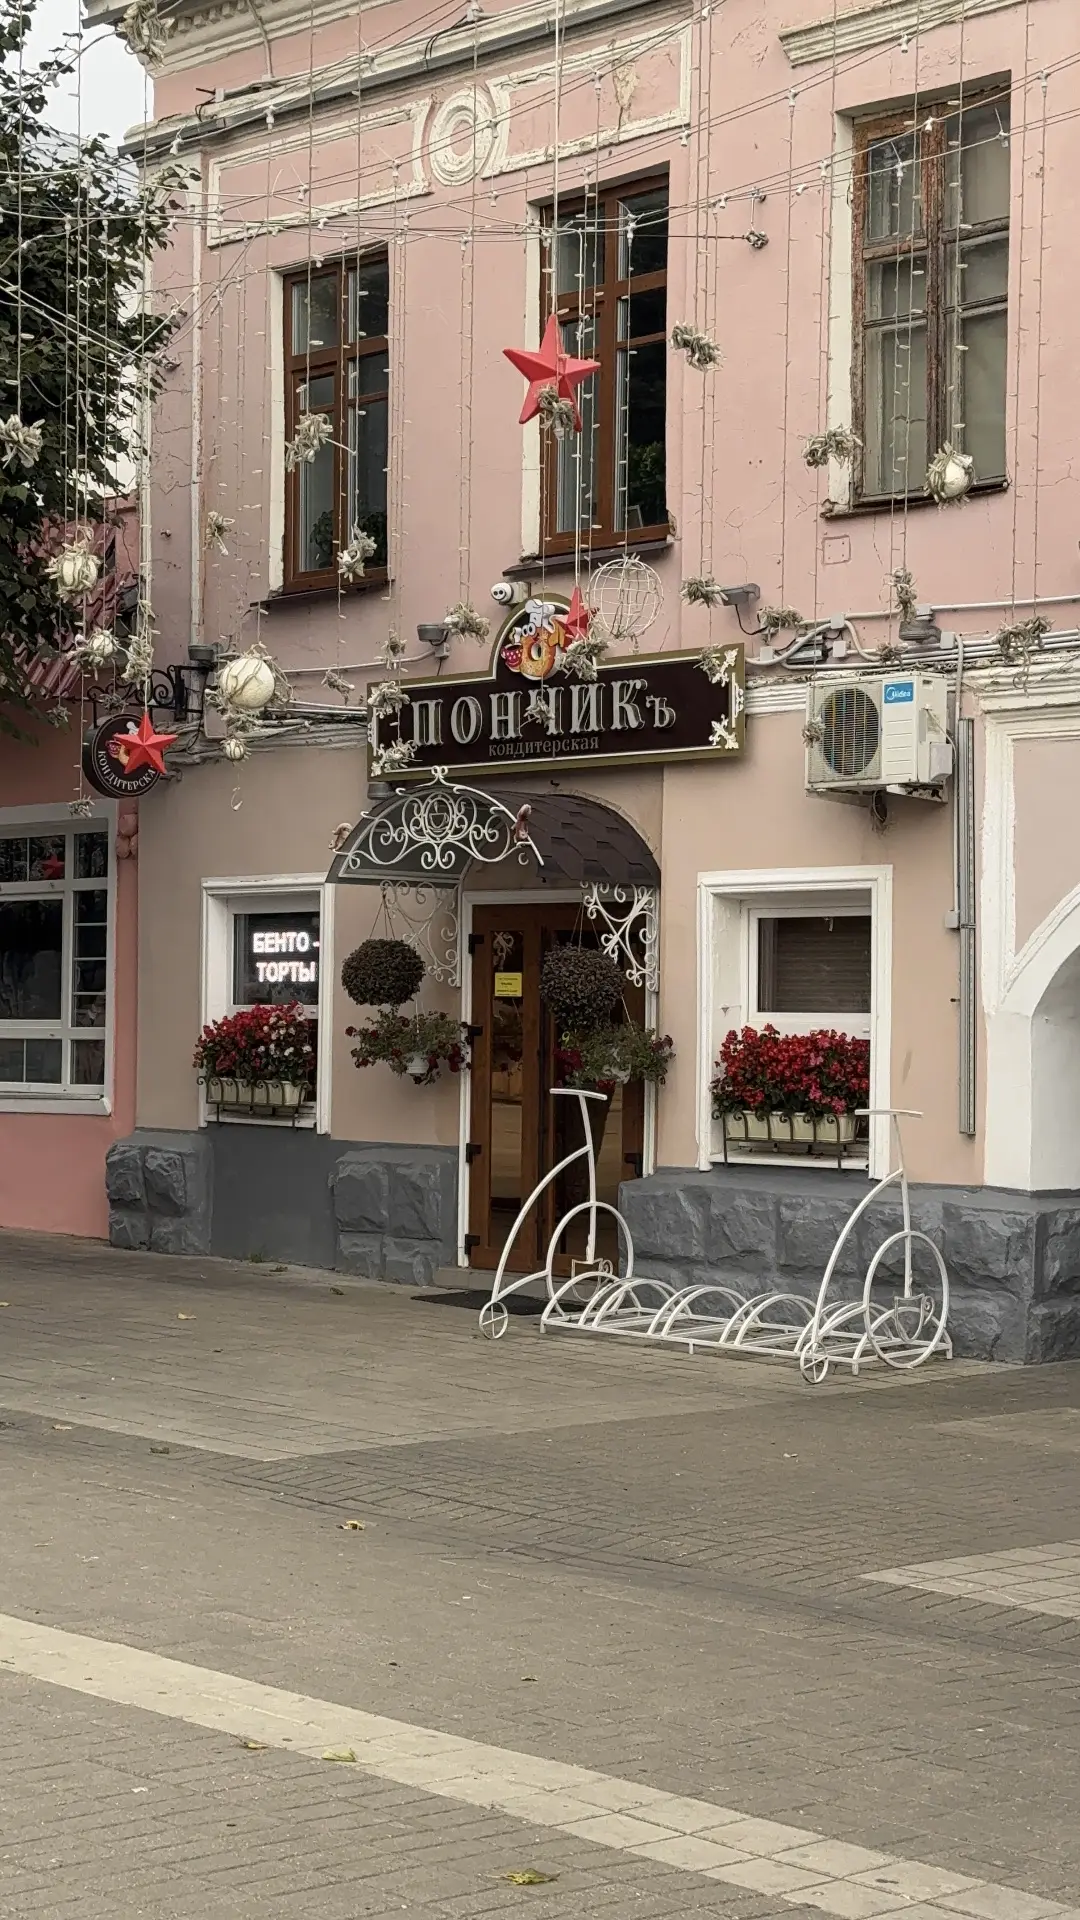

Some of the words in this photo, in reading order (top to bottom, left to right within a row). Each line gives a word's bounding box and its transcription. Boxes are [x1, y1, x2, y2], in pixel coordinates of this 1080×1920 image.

[488, 735, 600, 758] кондитерская
[98, 750, 156, 791] КОНДИТЕРСКА
[255, 961, 316, 983] ТОРТЫ
